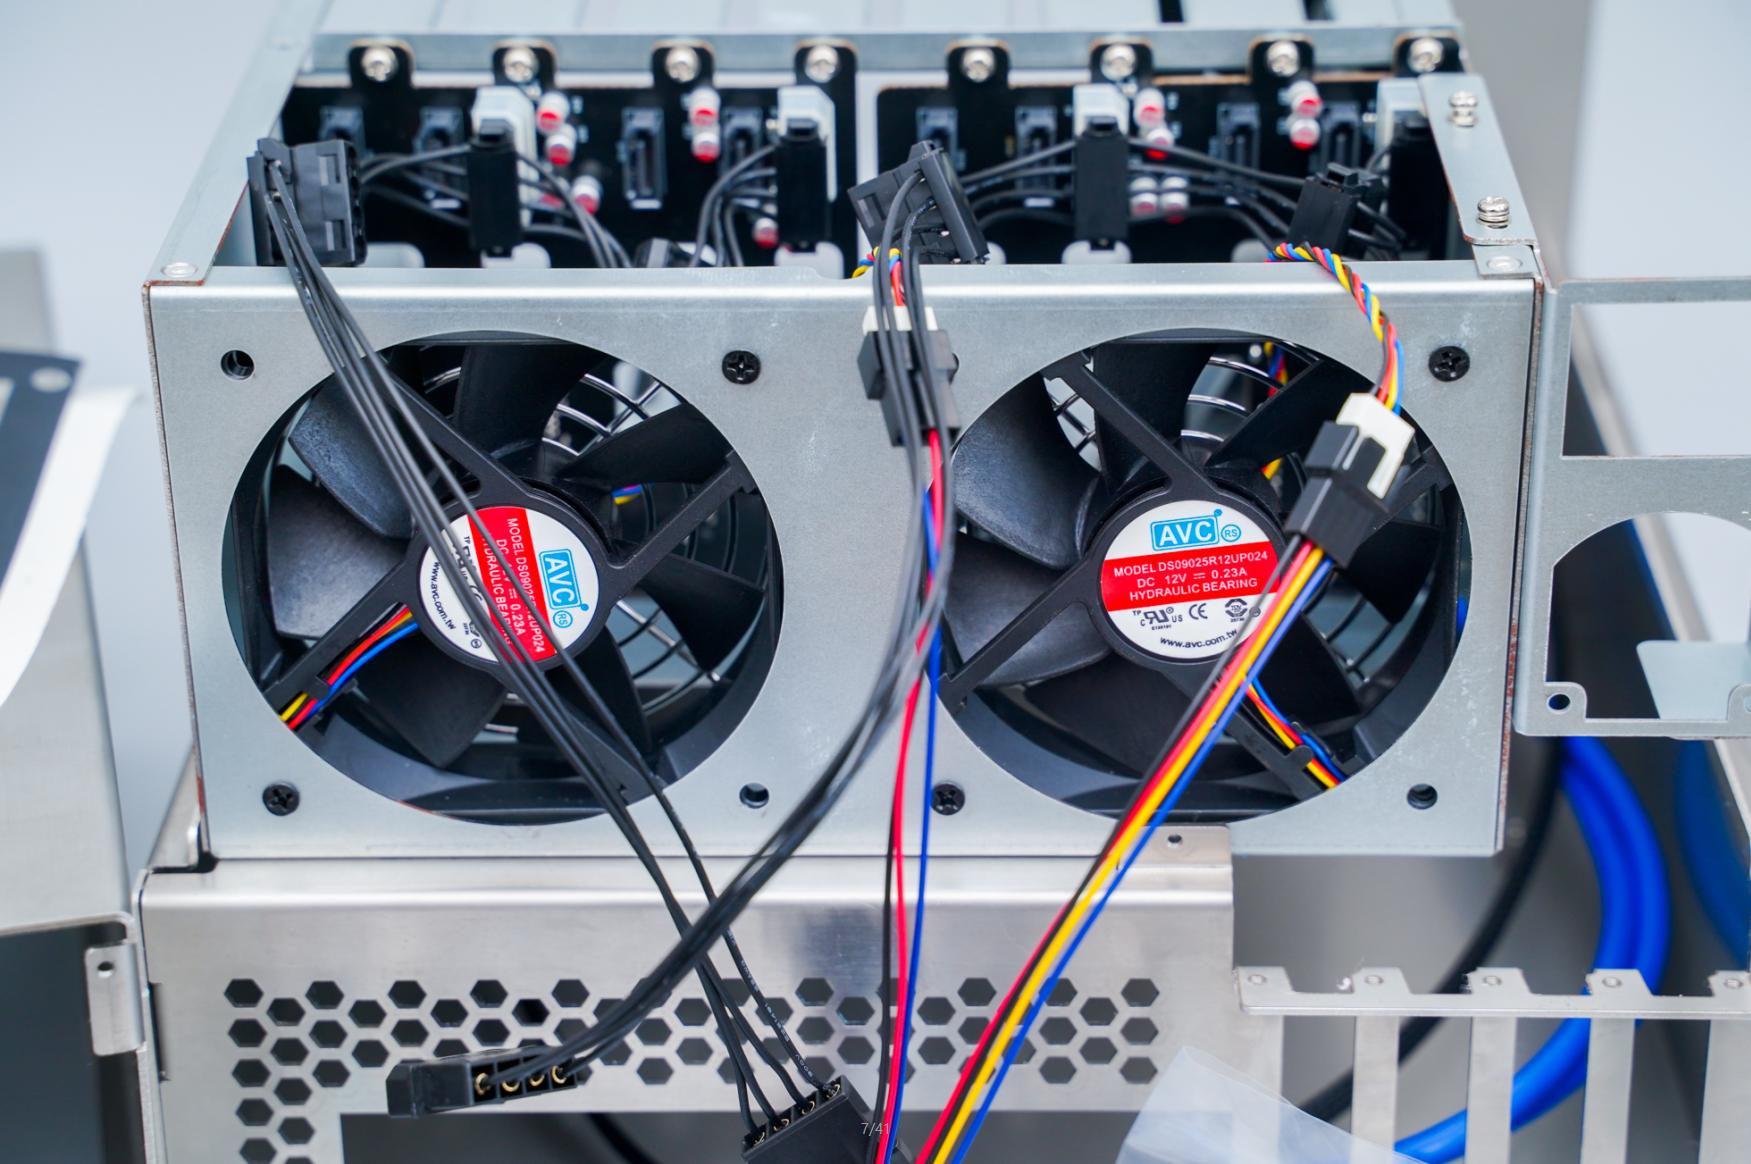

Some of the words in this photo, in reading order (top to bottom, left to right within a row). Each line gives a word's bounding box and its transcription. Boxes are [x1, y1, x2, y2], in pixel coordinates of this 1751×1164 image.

[507, 518, 524, 555] MODEL
[1159, 520, 1213, 546] AVC
[1114, 565, 1156, 577] MODEL
[1158, 551, 1268, 572] DS09025R12UP024
[496, 539, 510, 555] DC
[510, 604, 528, 636] 0.23A
[545, 557, 574, 603] AVC
[1129, 583, 1200, 601] HYDRAULIC
[1202, 578, 1258, 593] BEARING
[1136, 577, 1155, 589] DC
[1165, 573, 1187, 585] 12V
[1211, 567, 1248, 580] 0.23A
[1132, 609, 1142, 617] TP
[1160, 629, 1238, 649] www.avc.com.tw
